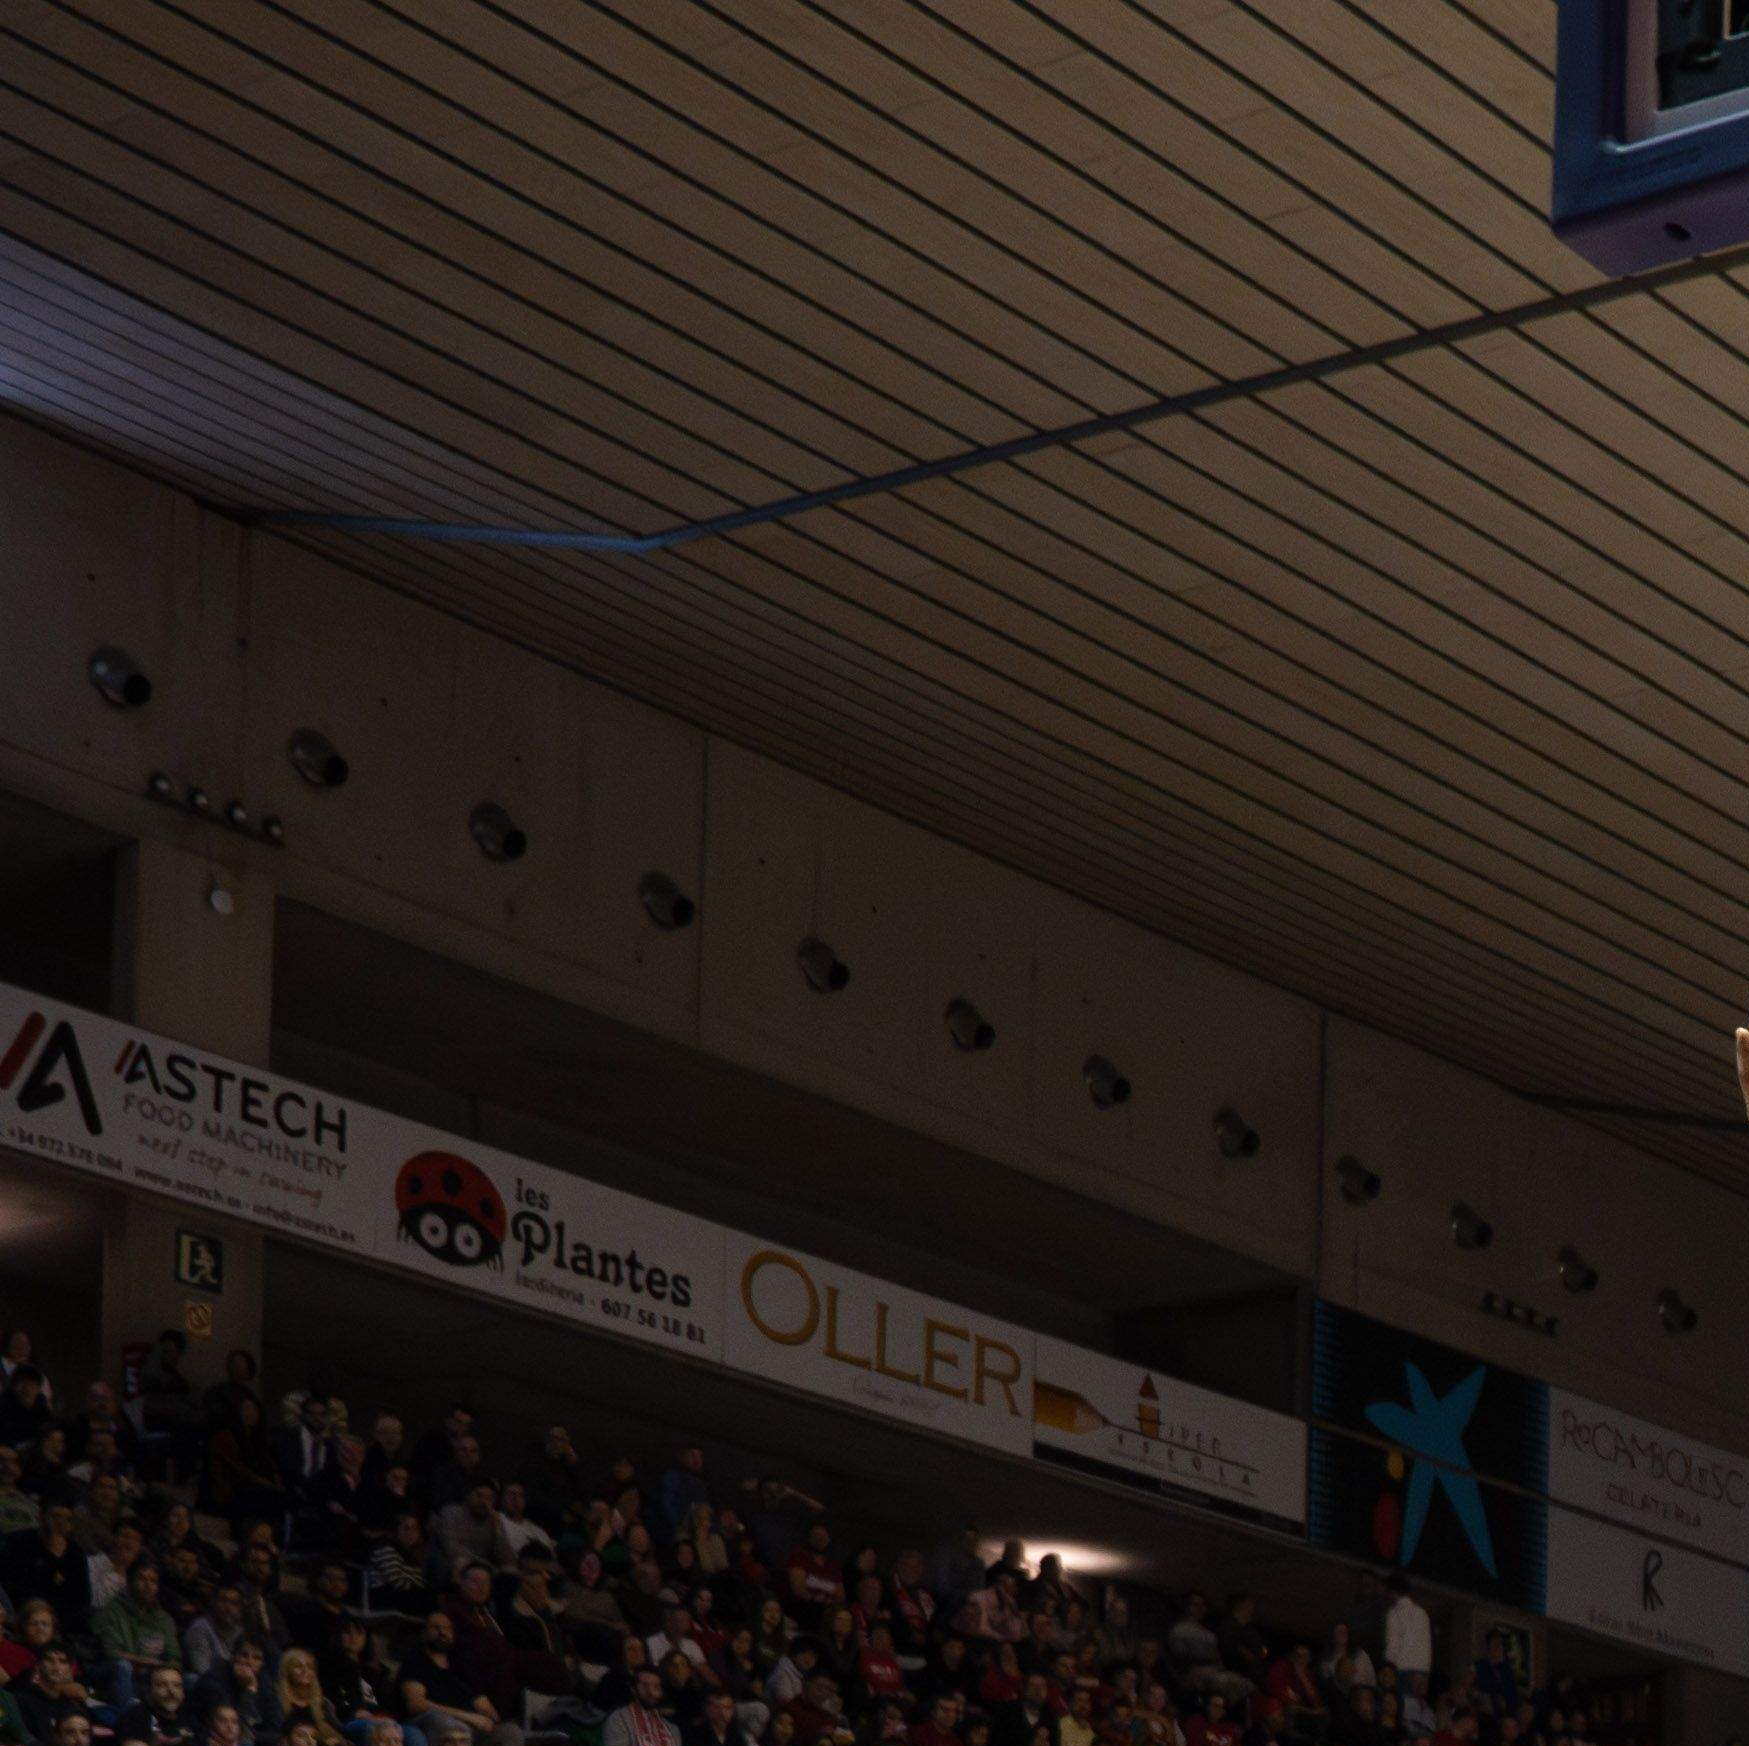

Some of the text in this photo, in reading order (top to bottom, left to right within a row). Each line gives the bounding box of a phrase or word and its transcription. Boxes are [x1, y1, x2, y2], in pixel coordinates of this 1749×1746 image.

[122, 1042, 348, 1154] ASTECH
[122, 1091, 195, 1133] FOOD
[202, 1119, 348, 1180] MACHINERY
[515, 1176, 550, 1211] les
[511, 1210, 692, 1308] Plantes
[740, 1250, 1023, 1418] OLLER
